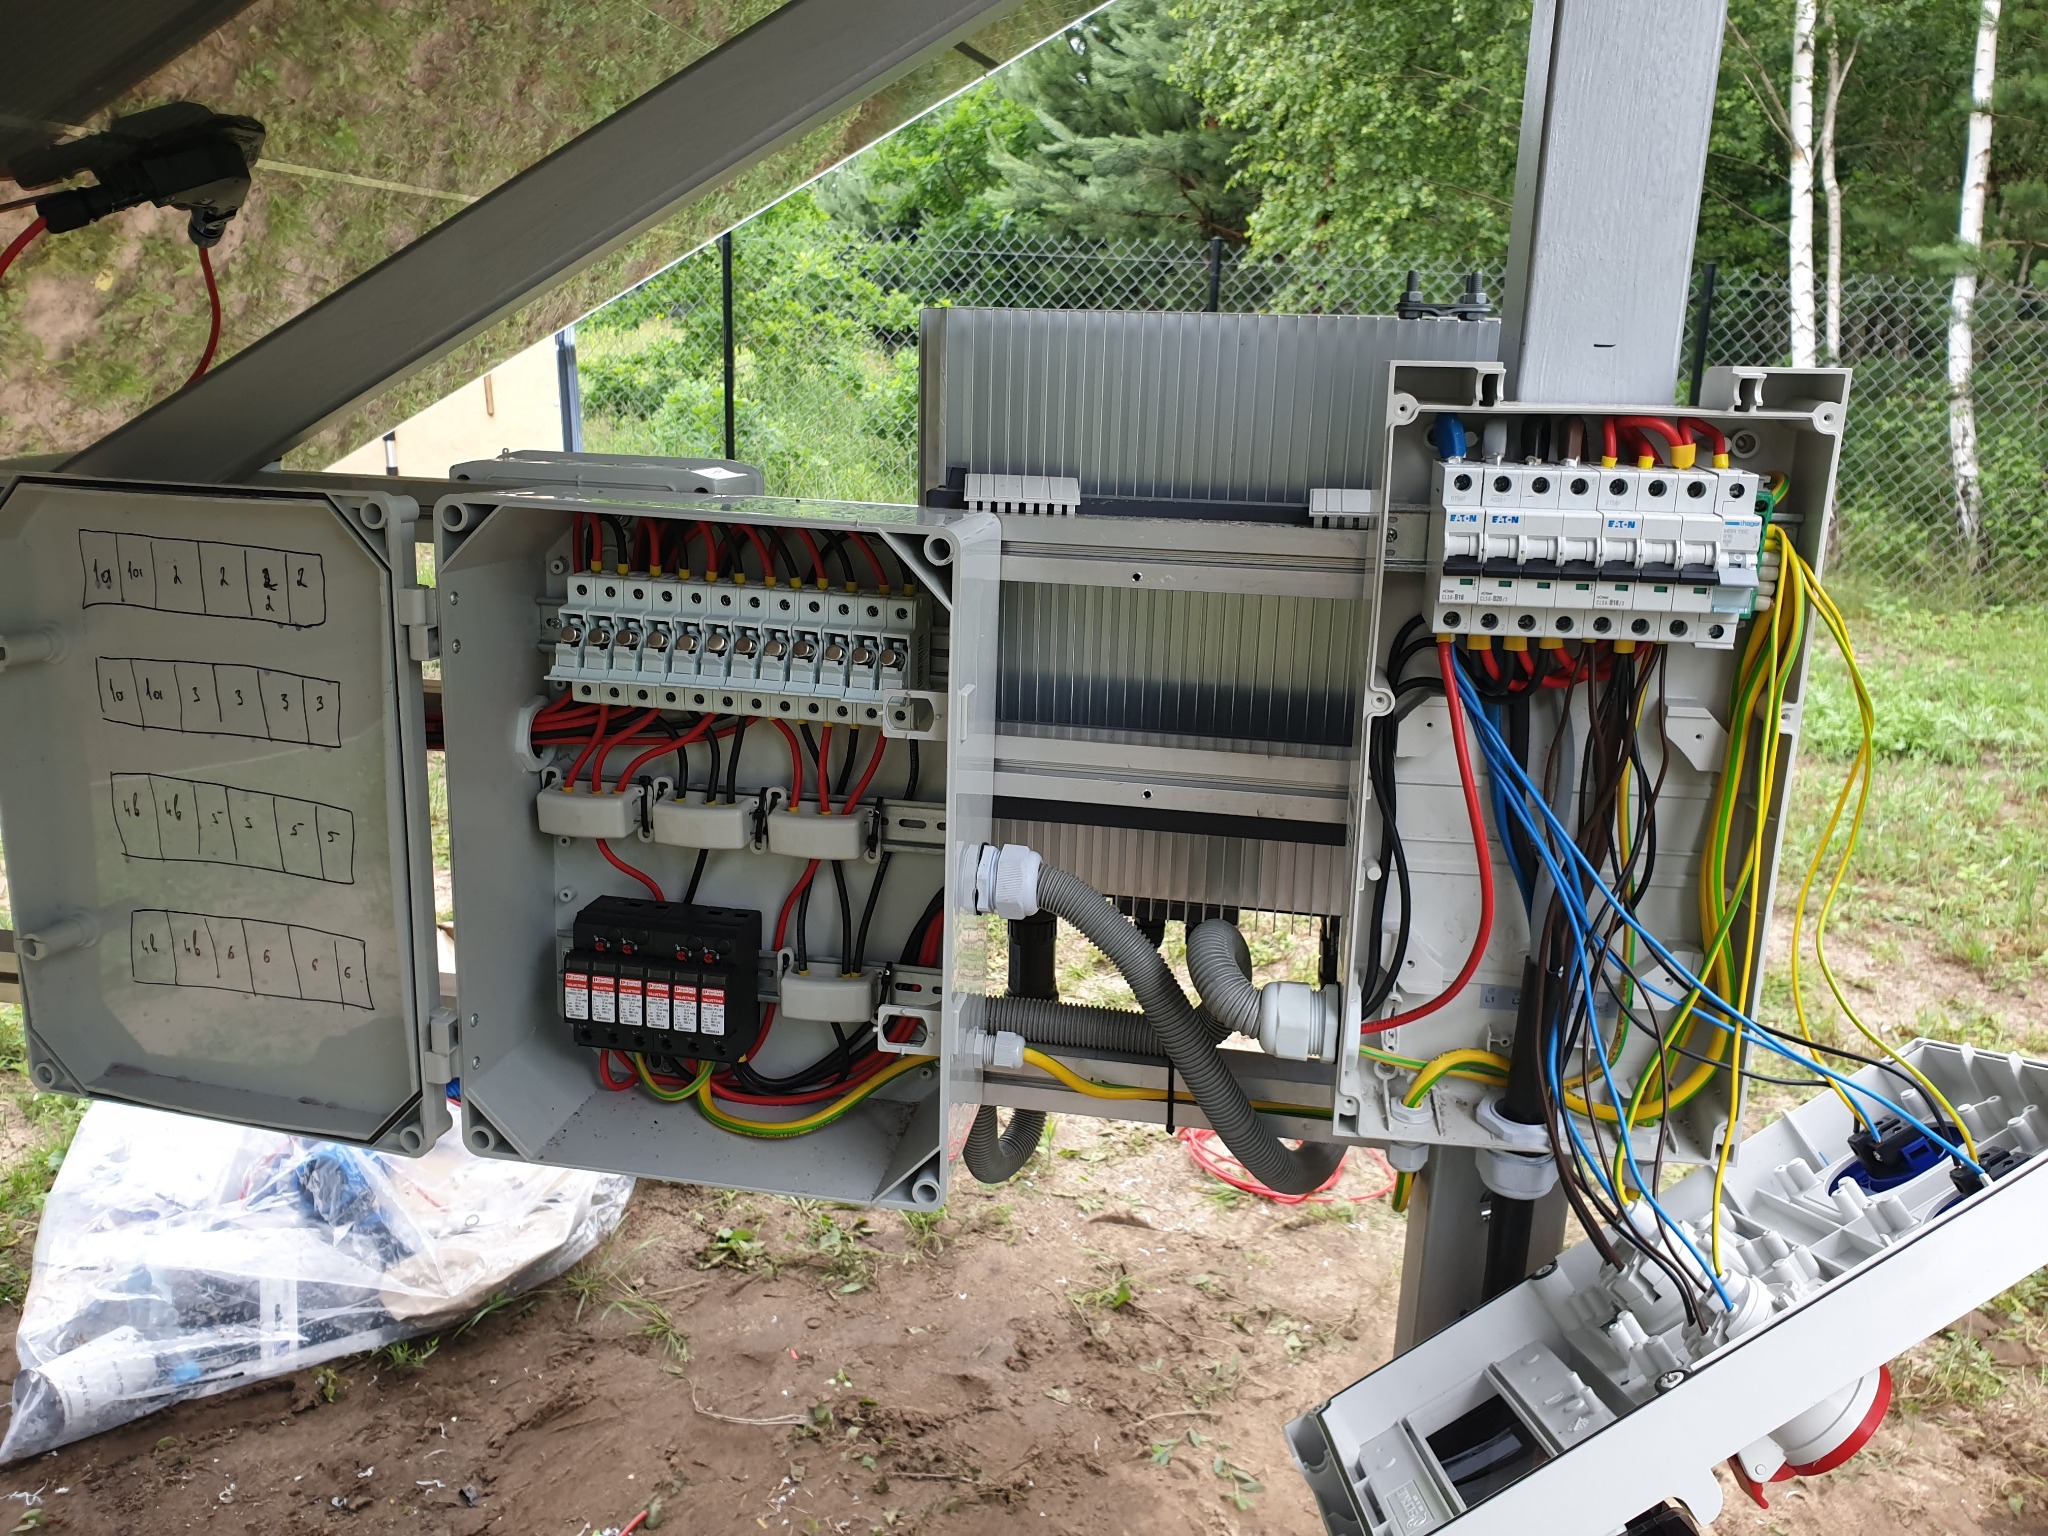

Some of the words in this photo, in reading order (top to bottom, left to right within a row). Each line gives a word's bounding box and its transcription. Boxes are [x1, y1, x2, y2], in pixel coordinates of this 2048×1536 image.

[220, 567, 229, 586] 2
[297, 568, 307, 588] 2
[192, 687, 201, 702] 3
[235, 689, 243, 706] 3
[281, 693, 289, 711] 3
[317, 696, 324, 712] 3
[290, 823, 304, 835] 5
[328, 831, 340, 842] 5
[227, 945, 235, 959] 6
[263, 949, 271, 963] 6
[344, 966, 351, 979] 6
